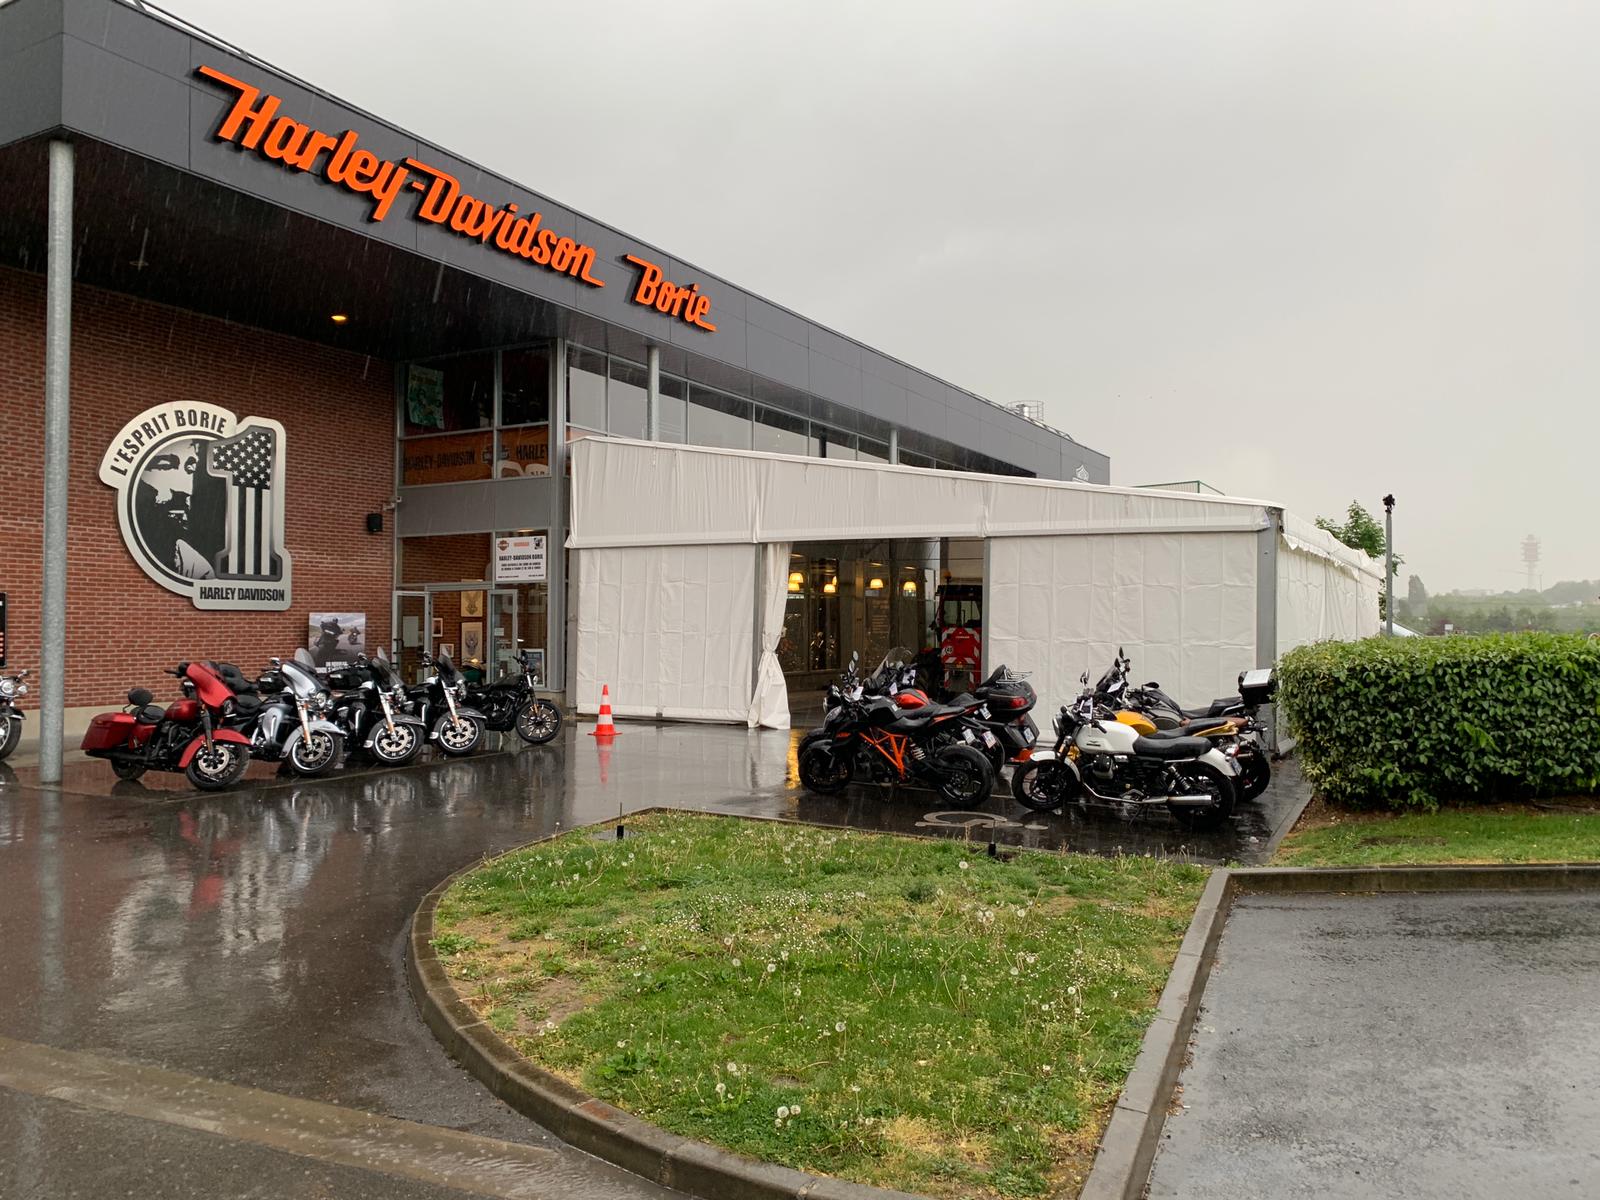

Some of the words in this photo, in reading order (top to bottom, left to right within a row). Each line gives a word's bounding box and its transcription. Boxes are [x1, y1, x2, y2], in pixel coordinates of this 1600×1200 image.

[200, 65, 604, 288] Harley-Davidson
[626, 254, 717, 332] Borie
[110, 413, 170, 476] L'ESPRIT
[174, 409, 227, 434] BORIE
[200, 587, 236, 600] HARLEY
[238, 588, 285, 601] DAVIDSON
